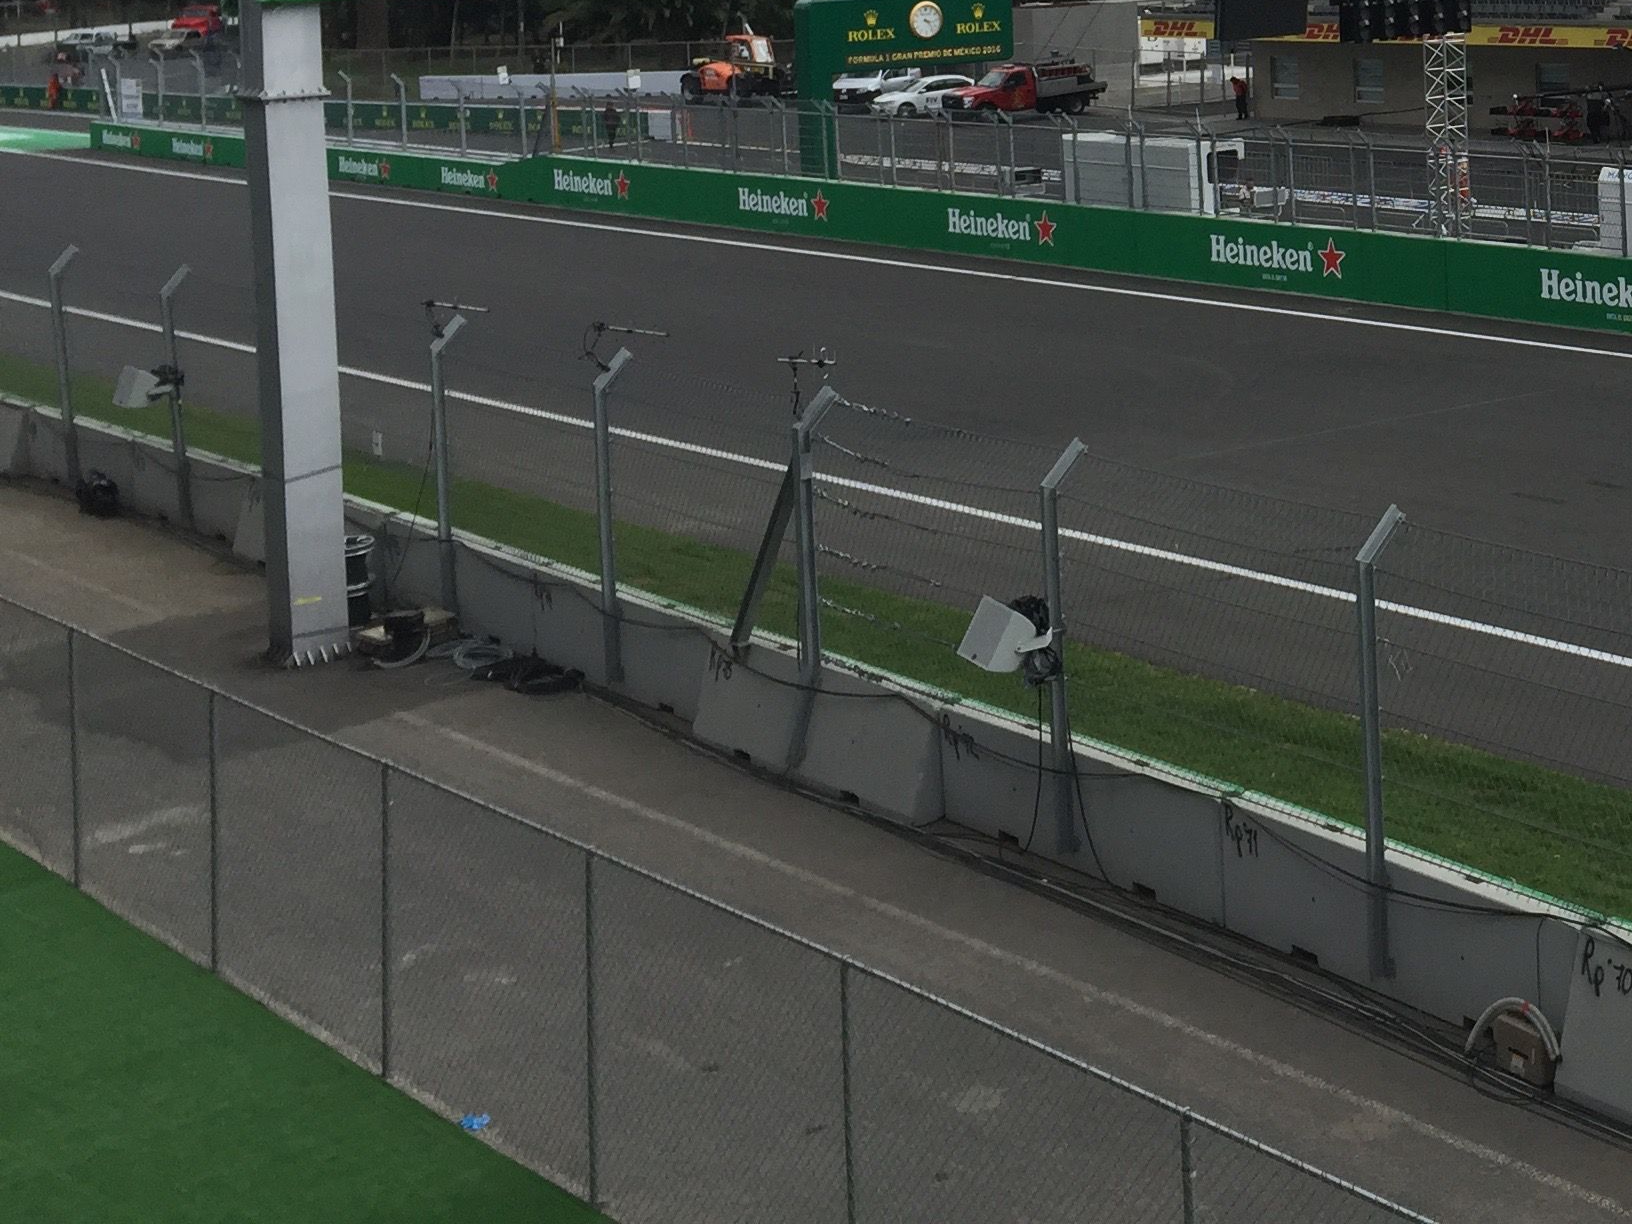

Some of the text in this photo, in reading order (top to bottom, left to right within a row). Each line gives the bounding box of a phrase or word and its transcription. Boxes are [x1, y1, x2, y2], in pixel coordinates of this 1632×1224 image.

[847, 28, 896, 42] ROLEX
[956, 20, 1002, 35] ROLEX
[1154, 21, 1198, 38] DHL
[1500, 26, 1557, 44] DHL
